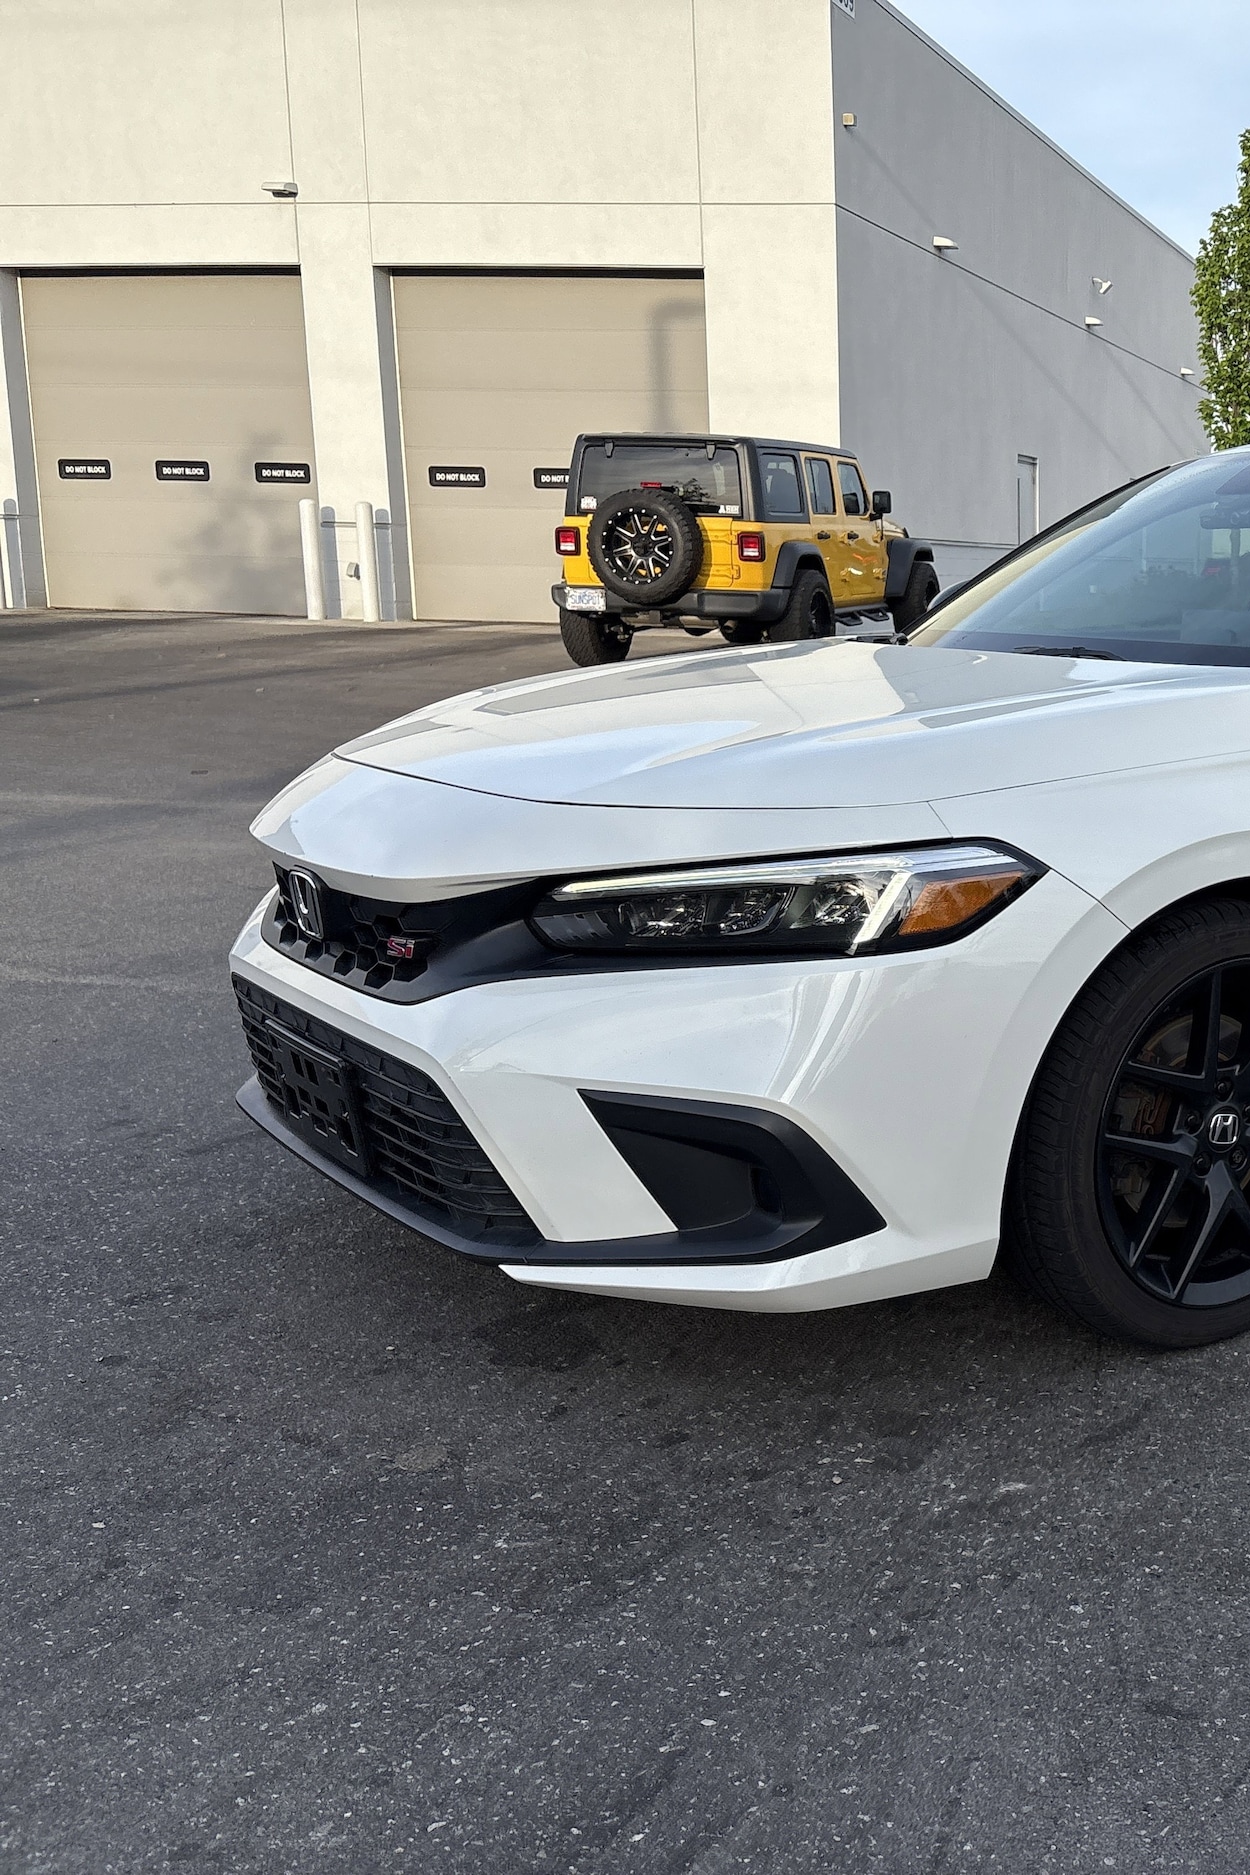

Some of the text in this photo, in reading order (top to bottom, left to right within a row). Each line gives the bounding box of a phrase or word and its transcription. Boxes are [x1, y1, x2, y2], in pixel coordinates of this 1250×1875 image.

[65, 465, 106, 474] DO NOT BLOCK
[162, 466, 205, 476] DO NOT BLOCK
[261, 468, 305, 478] DO NOT BLOCK
[436, 472, 480, 482] DO NOT BLOCK
[541, 474, 551, 483] DO
[551, 474, 564, 483] NOT
[387, 935, 415, 958] Si
